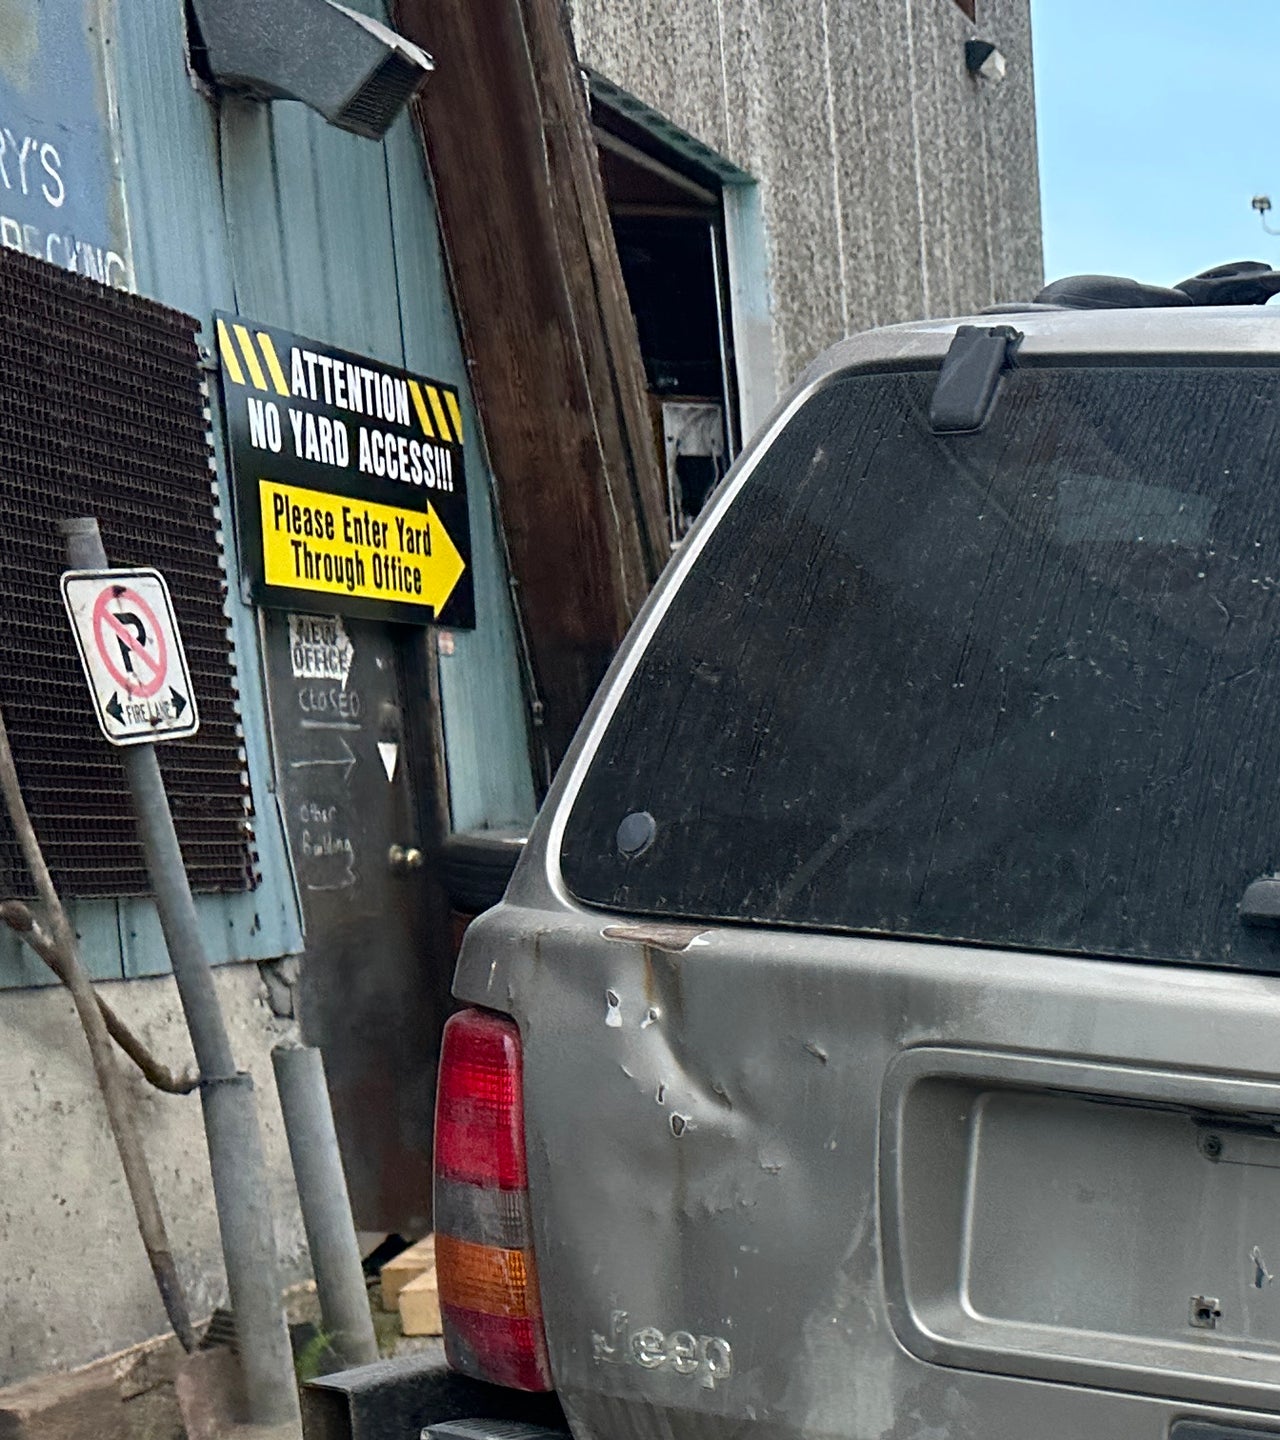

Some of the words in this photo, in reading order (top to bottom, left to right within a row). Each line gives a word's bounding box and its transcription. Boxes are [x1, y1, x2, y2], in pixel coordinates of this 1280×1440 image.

[291, 347, 411, 427] ATTENTION
[247, 397, 282, 453] NO
[288, 407, 349, 468] YARD
[359, 426, 454, 492] ACCESS!!!
[273, 492, 335, 540] Please
[342, 506, 388, 549] Enter
[395, 516, 432, 557] Yard
[290, 539, 365, 592] Through
[372, 553, 422, 595] Office
[293, 643, 349, 675] OFFICE
[126, 703, 149, 724] FIRE
[299, 687, 360, 718] CLOSED
[591, 1310, 731, 1390] Jeep
